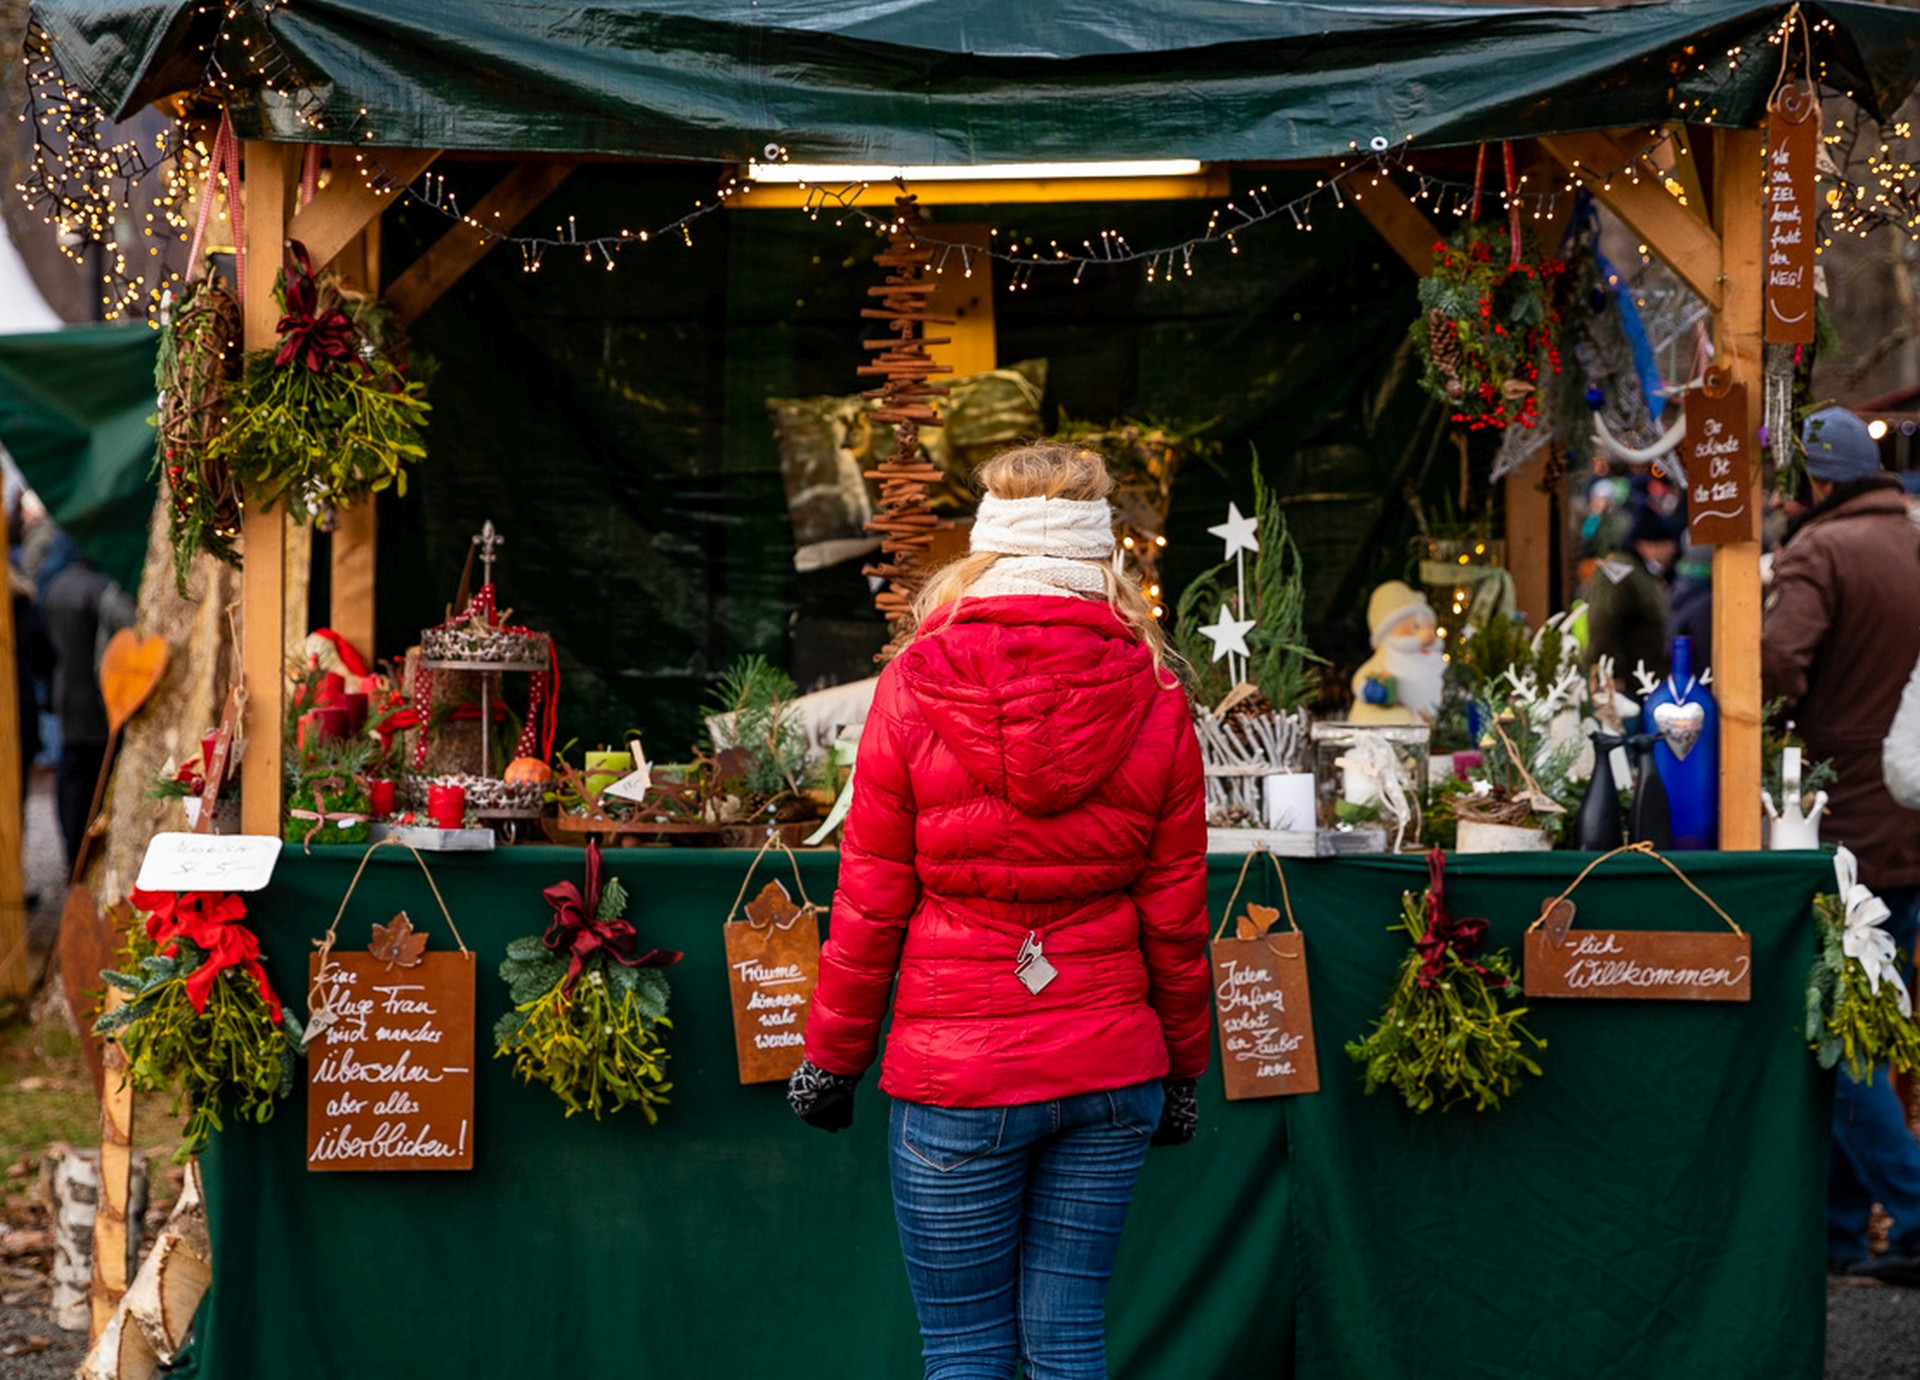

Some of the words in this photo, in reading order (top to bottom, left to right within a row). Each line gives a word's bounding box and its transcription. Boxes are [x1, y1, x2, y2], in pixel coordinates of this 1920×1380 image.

[1770, 266, 1804, 290] WEG!
[1564, 955, 1750, 989] Willkommen
[746, 991, 807, 1011] können
[754, 1031, 806, 1050] werden
[326, 1091, 369, 1117] aber
[372, 1091, 420, 1115] alles
